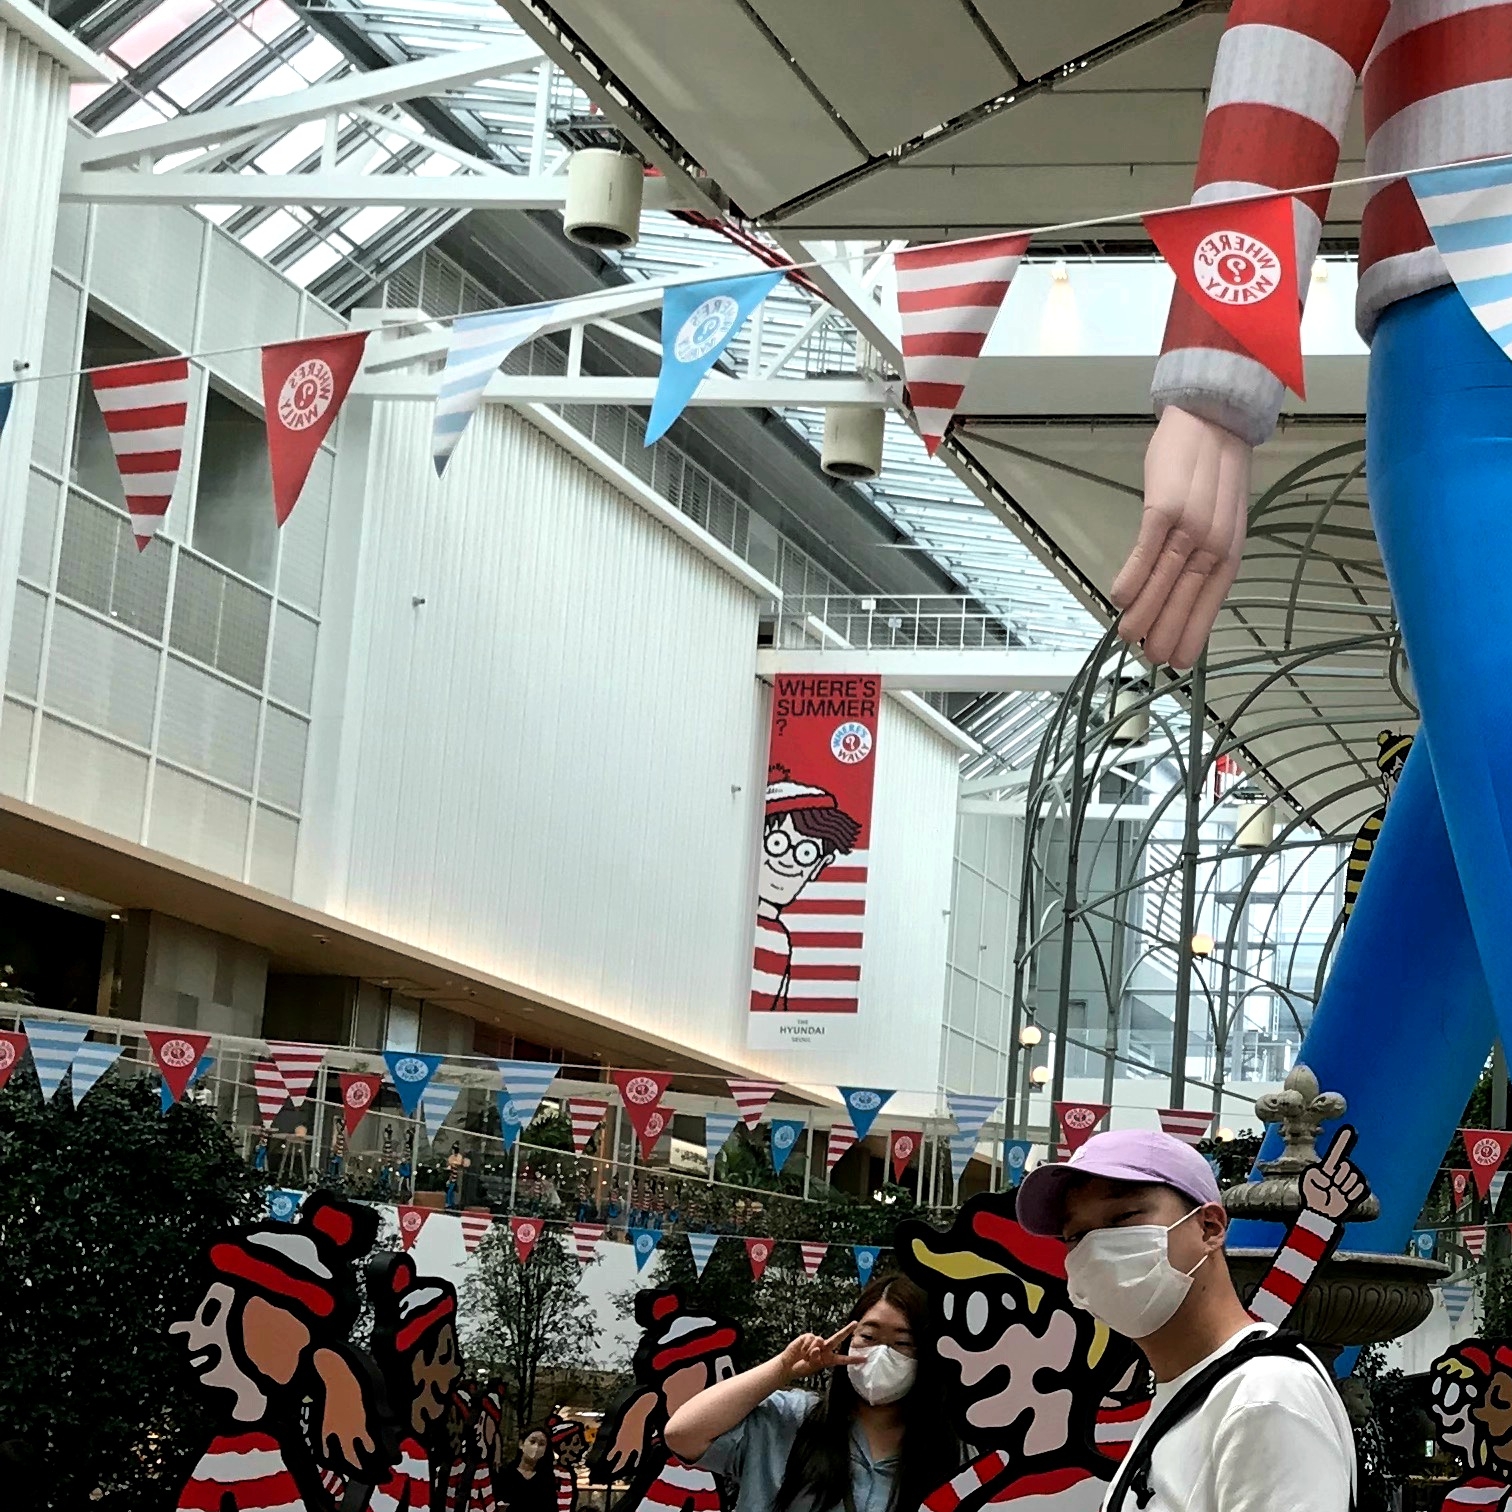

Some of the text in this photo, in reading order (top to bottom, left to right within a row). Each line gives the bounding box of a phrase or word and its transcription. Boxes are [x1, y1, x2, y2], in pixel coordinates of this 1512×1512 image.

[778, 678, 876, 698] WHERE'S
[776, 699, 875, 717] SUMMER
[776, 719, 788, 737] ?
[837, 742, 870, 762] WALLY
[779, 1026, 826, 1035] HYUNDAI
